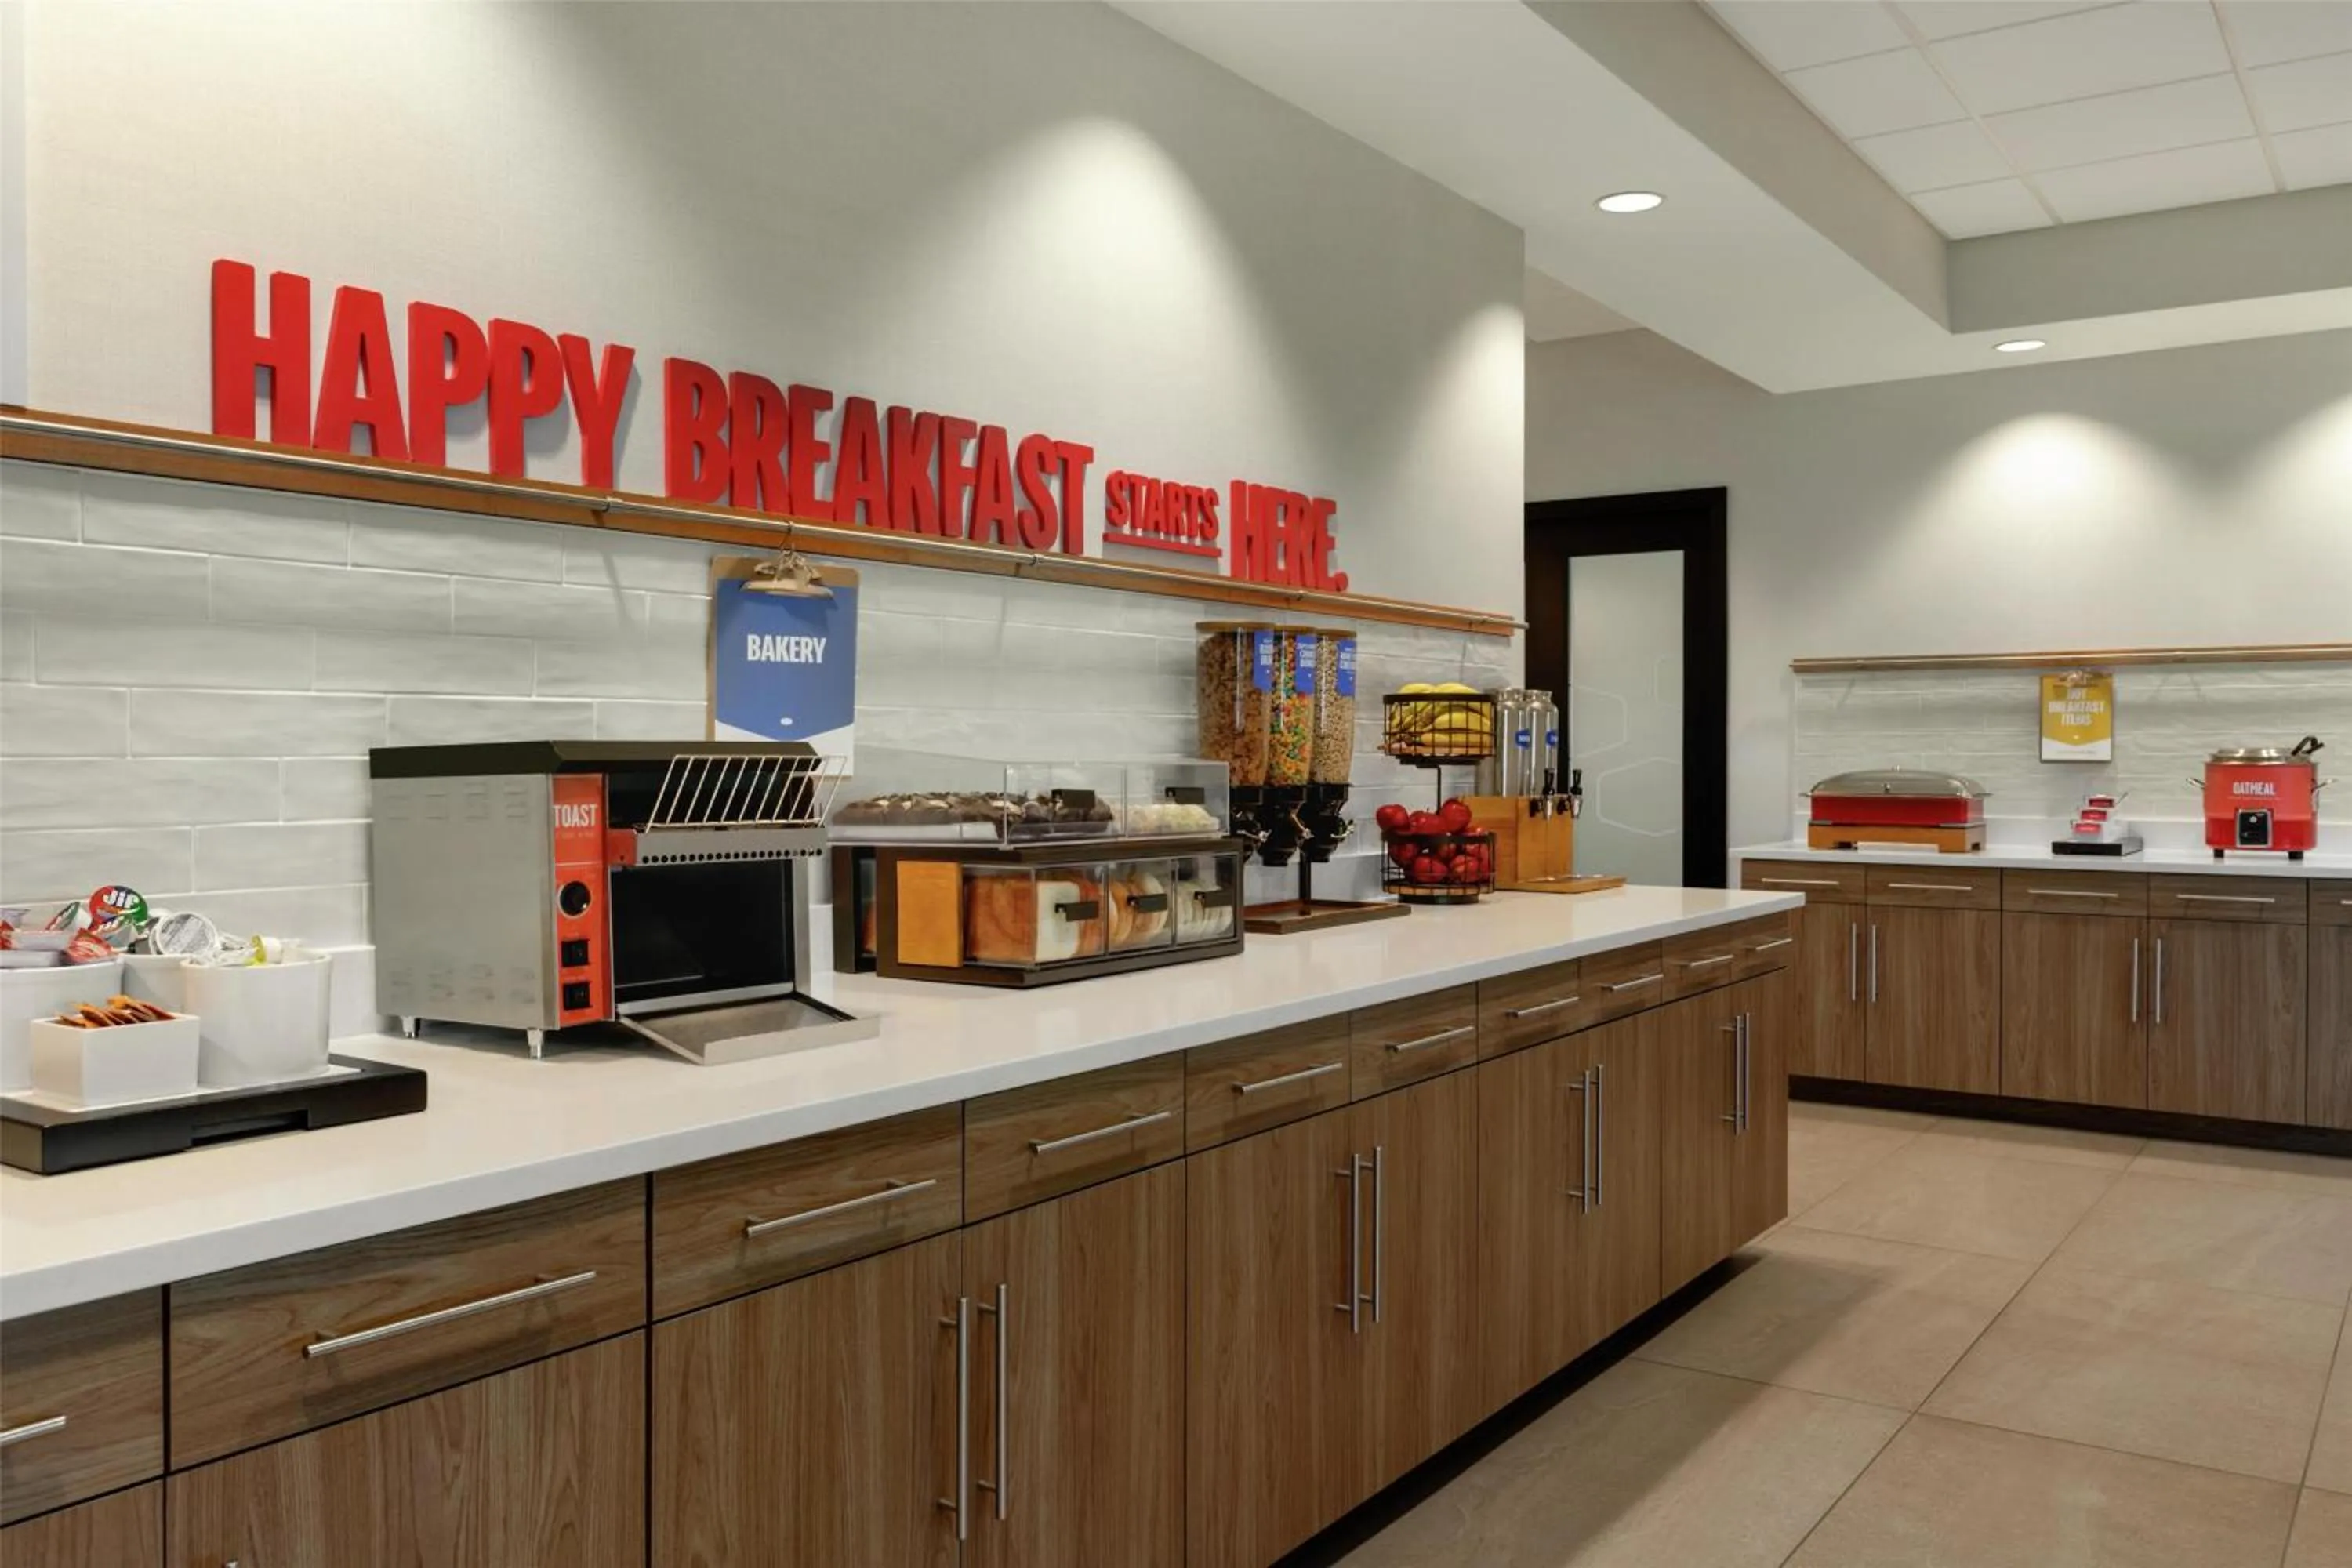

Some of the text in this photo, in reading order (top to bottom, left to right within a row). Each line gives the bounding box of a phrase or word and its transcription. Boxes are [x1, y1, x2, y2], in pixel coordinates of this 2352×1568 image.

[212, 258, 1349, 593] HAPPY BREAKFAST STARTS HERE.
[747, 633, 826, 664] BAKERY
[2232, 781, 2276, 796] OATMEAL
[552, 804, 598, 828] TOAST
